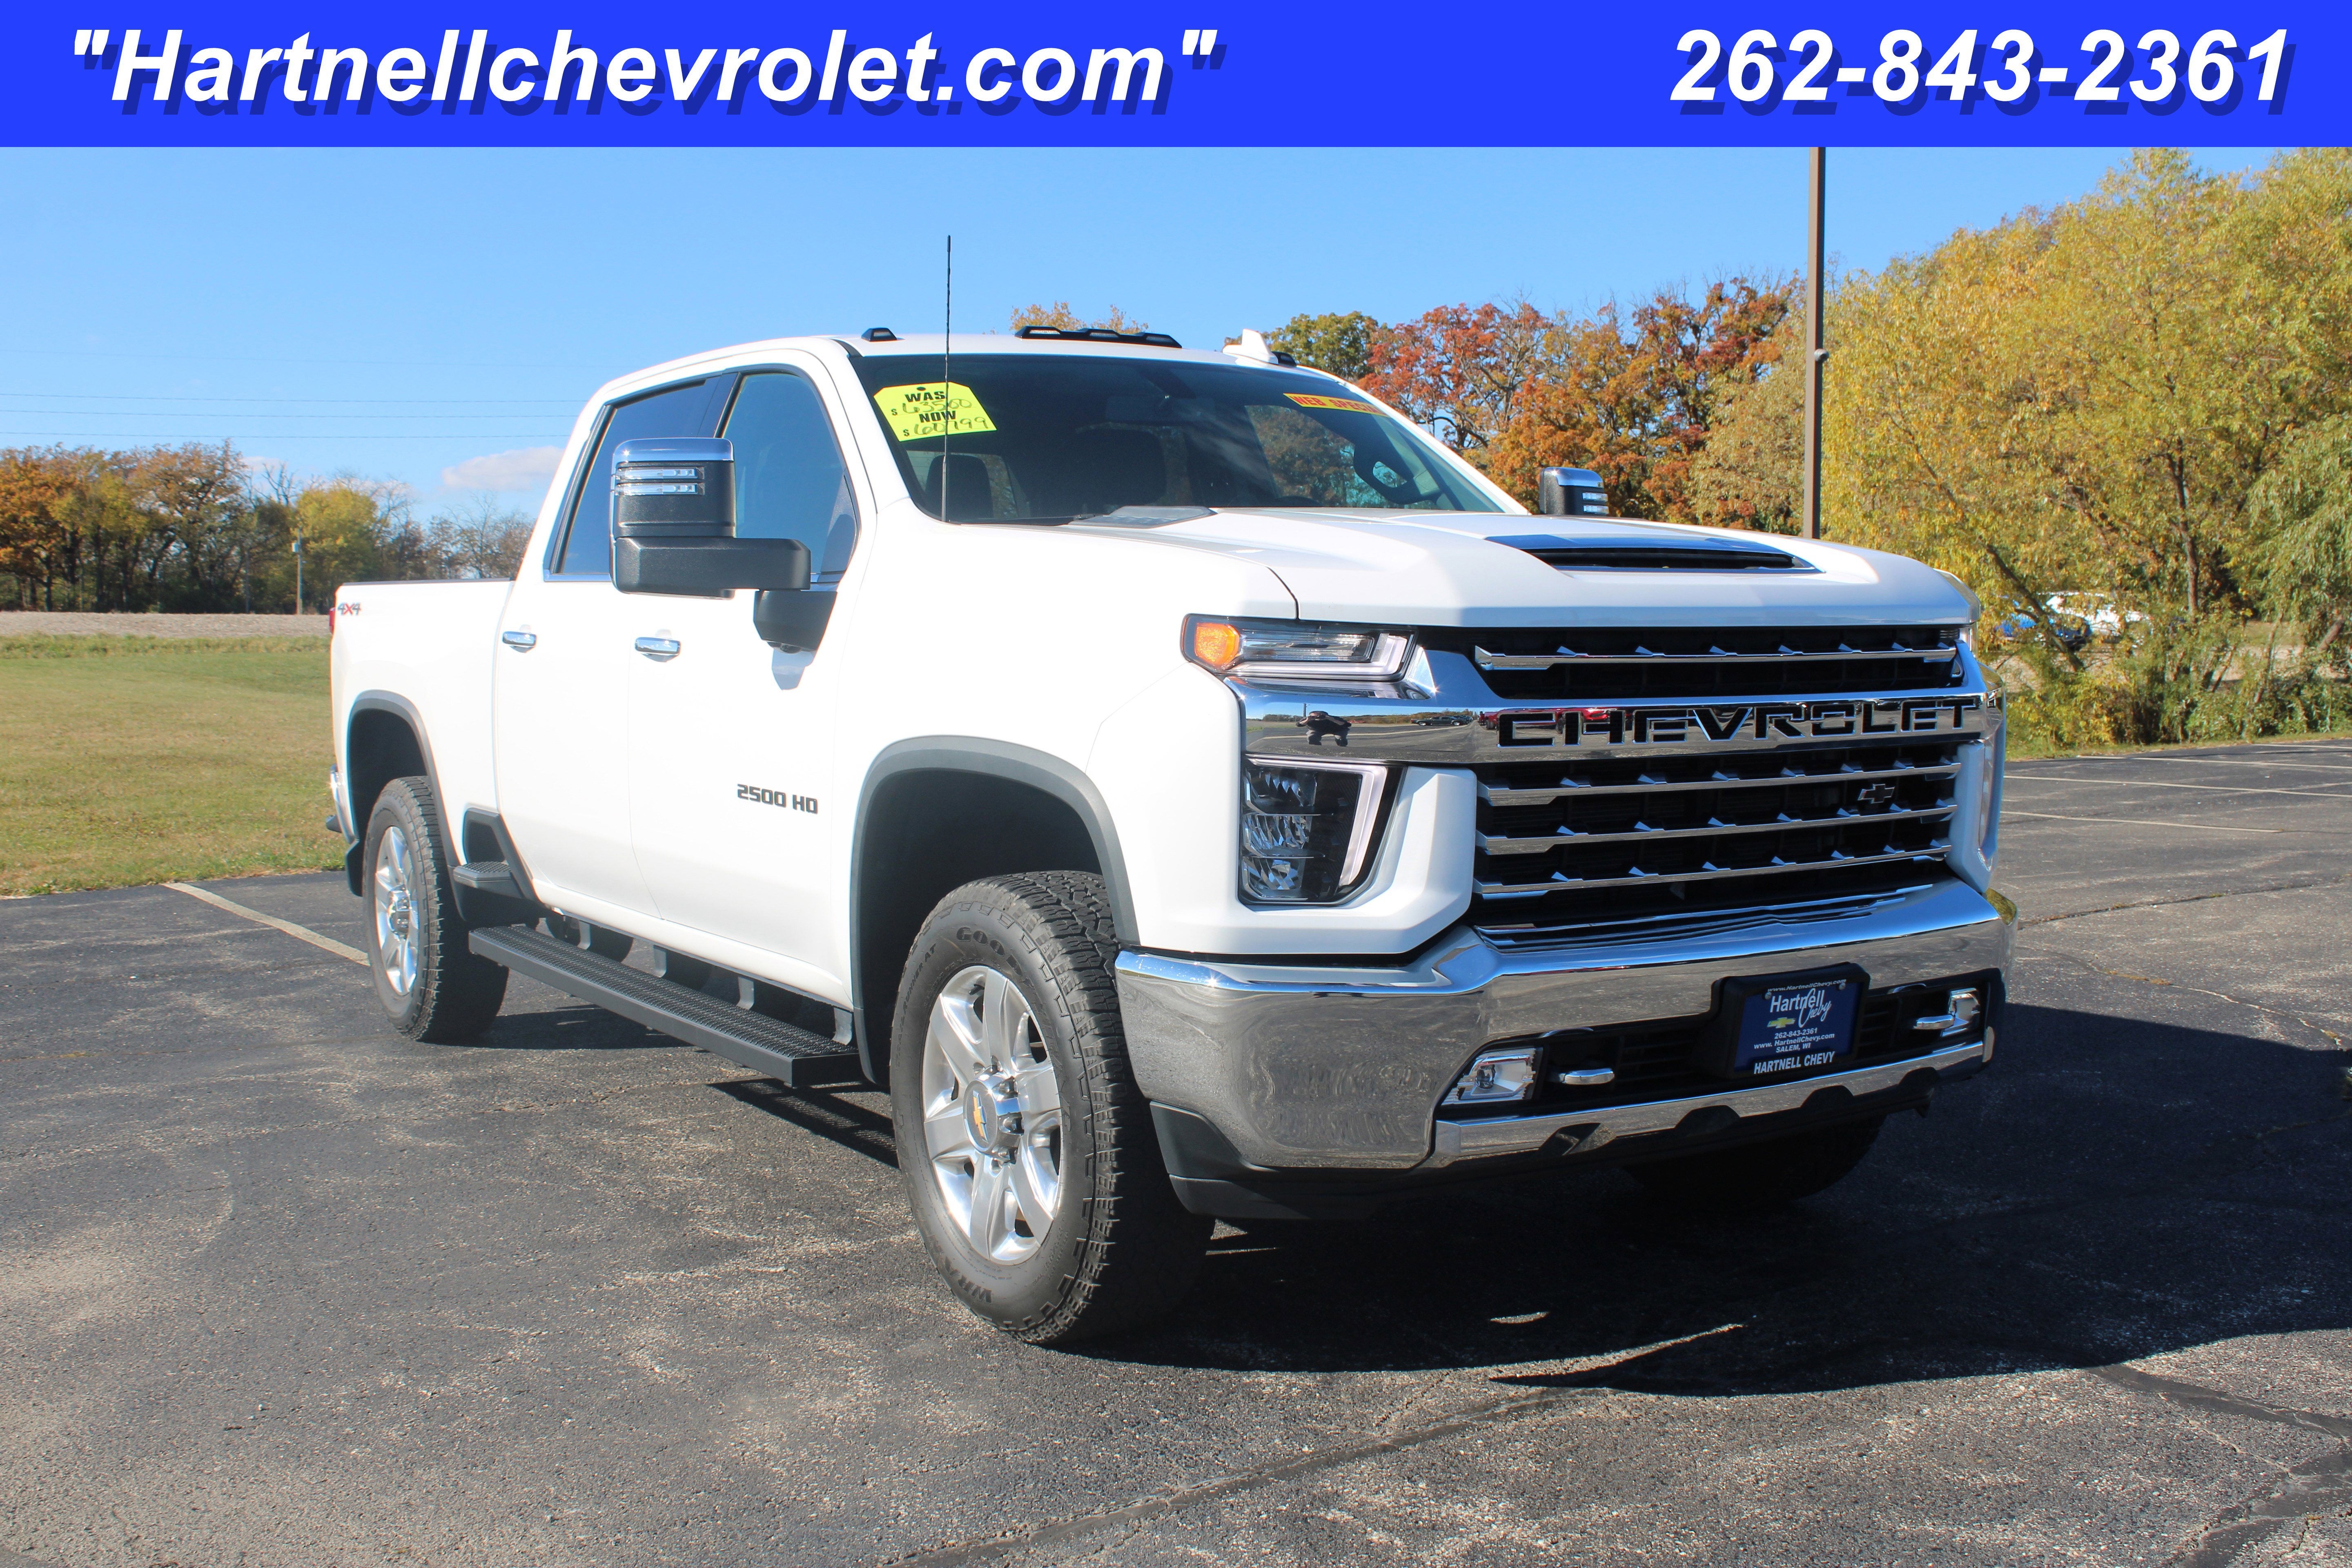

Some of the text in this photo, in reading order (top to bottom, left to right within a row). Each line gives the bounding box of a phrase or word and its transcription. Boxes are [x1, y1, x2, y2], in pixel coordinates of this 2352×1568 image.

[904, 391, 946, 402] WAS
[1290, 396, 1326, 406] WEB
[919, 410, 956, 423] NOW
[1496, 698, 1976, 748] CHEVROLET
[737, 783, 818, 814] 2500 HD
[1768, 979, 1846, 992] www.HartnellChevy.com
[1770, 989, 1825, 1013] Hartnell
[1798, 988, 1831, 1028] Chevy
[1774, 1027, 1817, 1039] 262-843-2361
[1775, 1044, 1800, 1053] SALEM,
[1753, 1051, 1835, 1074] HARTNELL CHEVY
